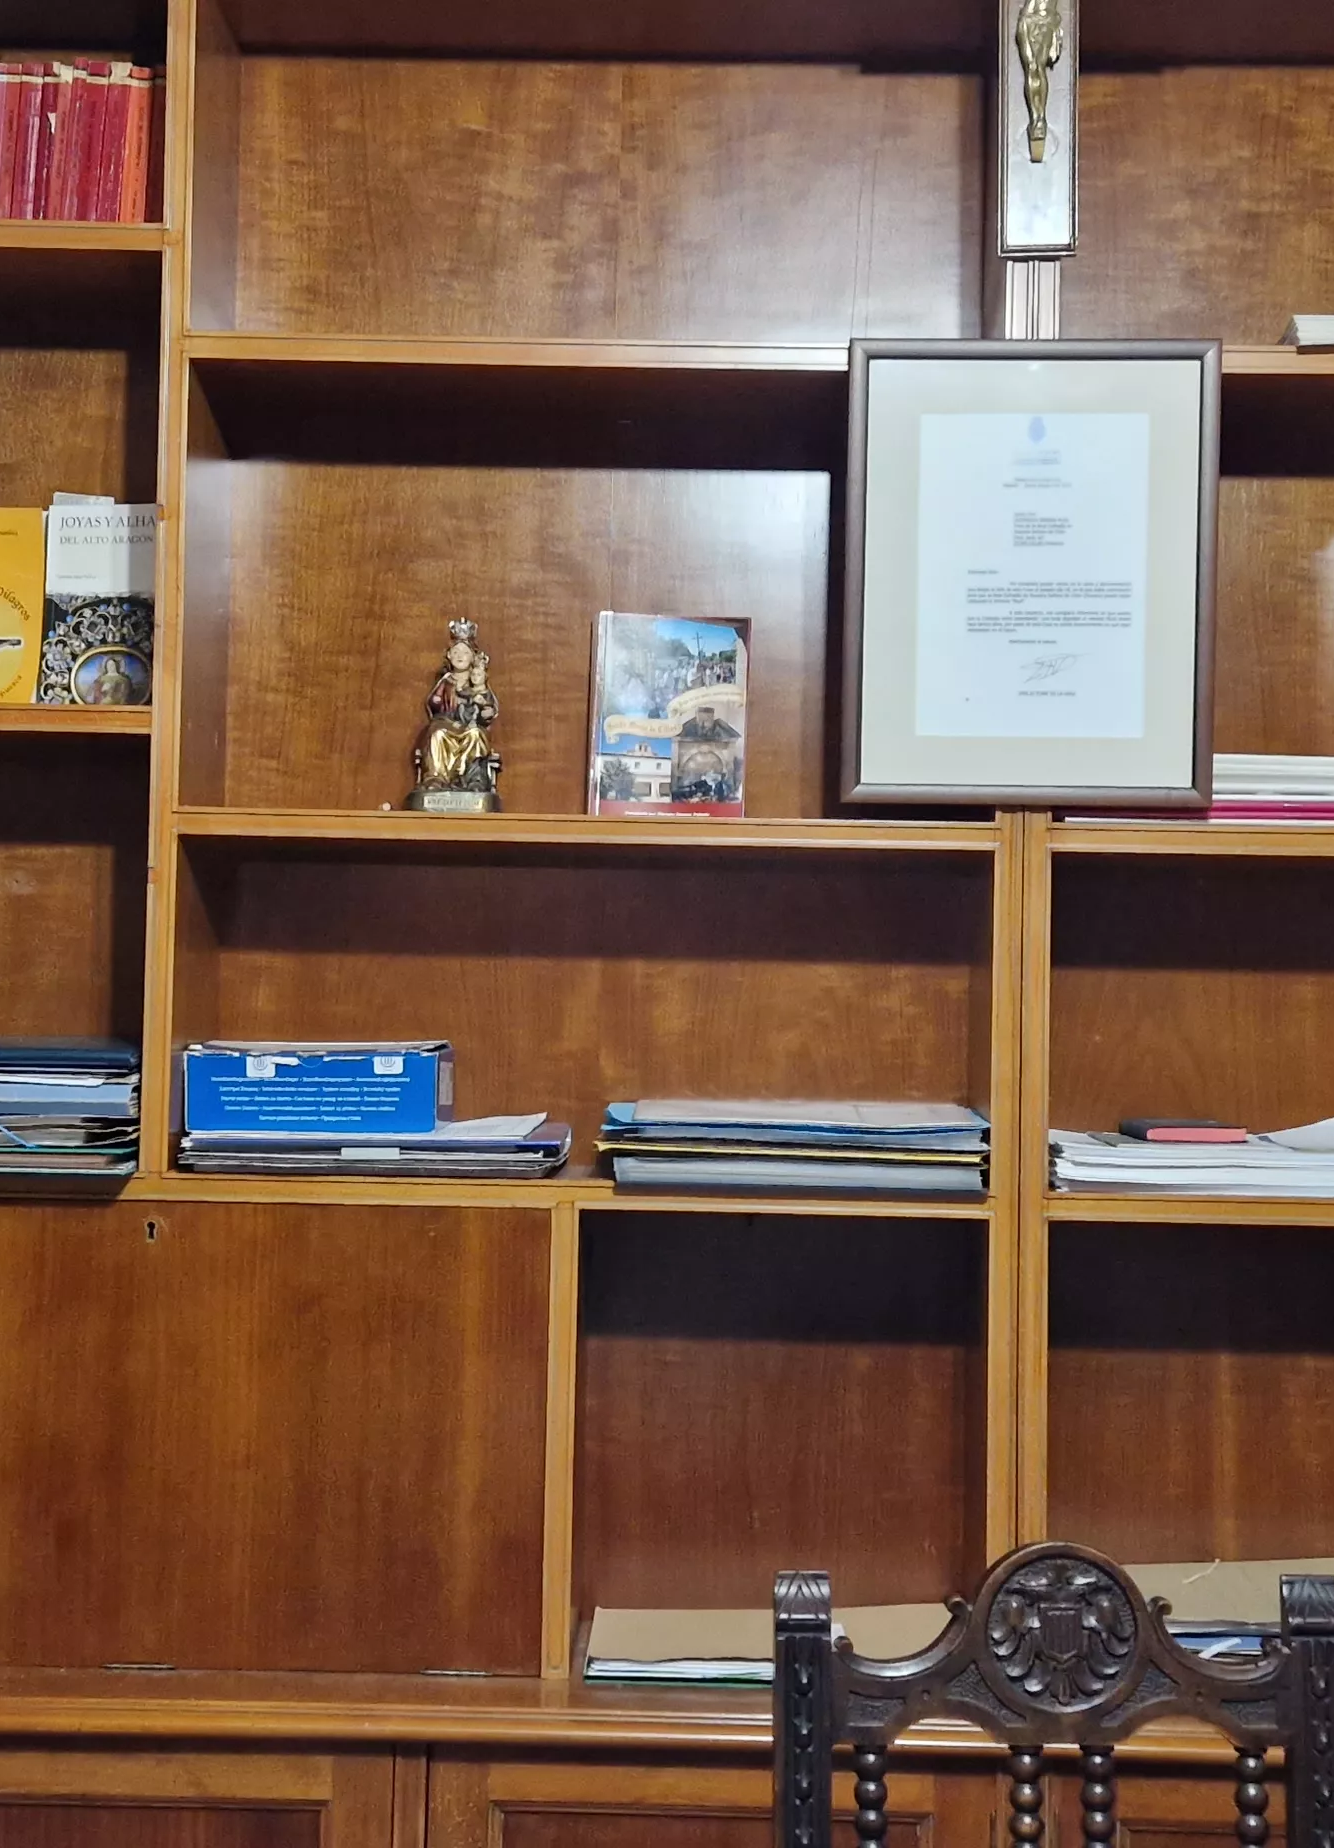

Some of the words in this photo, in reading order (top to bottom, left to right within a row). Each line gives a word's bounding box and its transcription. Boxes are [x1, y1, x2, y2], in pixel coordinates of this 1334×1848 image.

[59, 515, 103, 532] JOYAS
[104, 516, 115, 528] Y
[59, 535, 80, 545] DEL
[81, 535, 109, 545] ALTO
